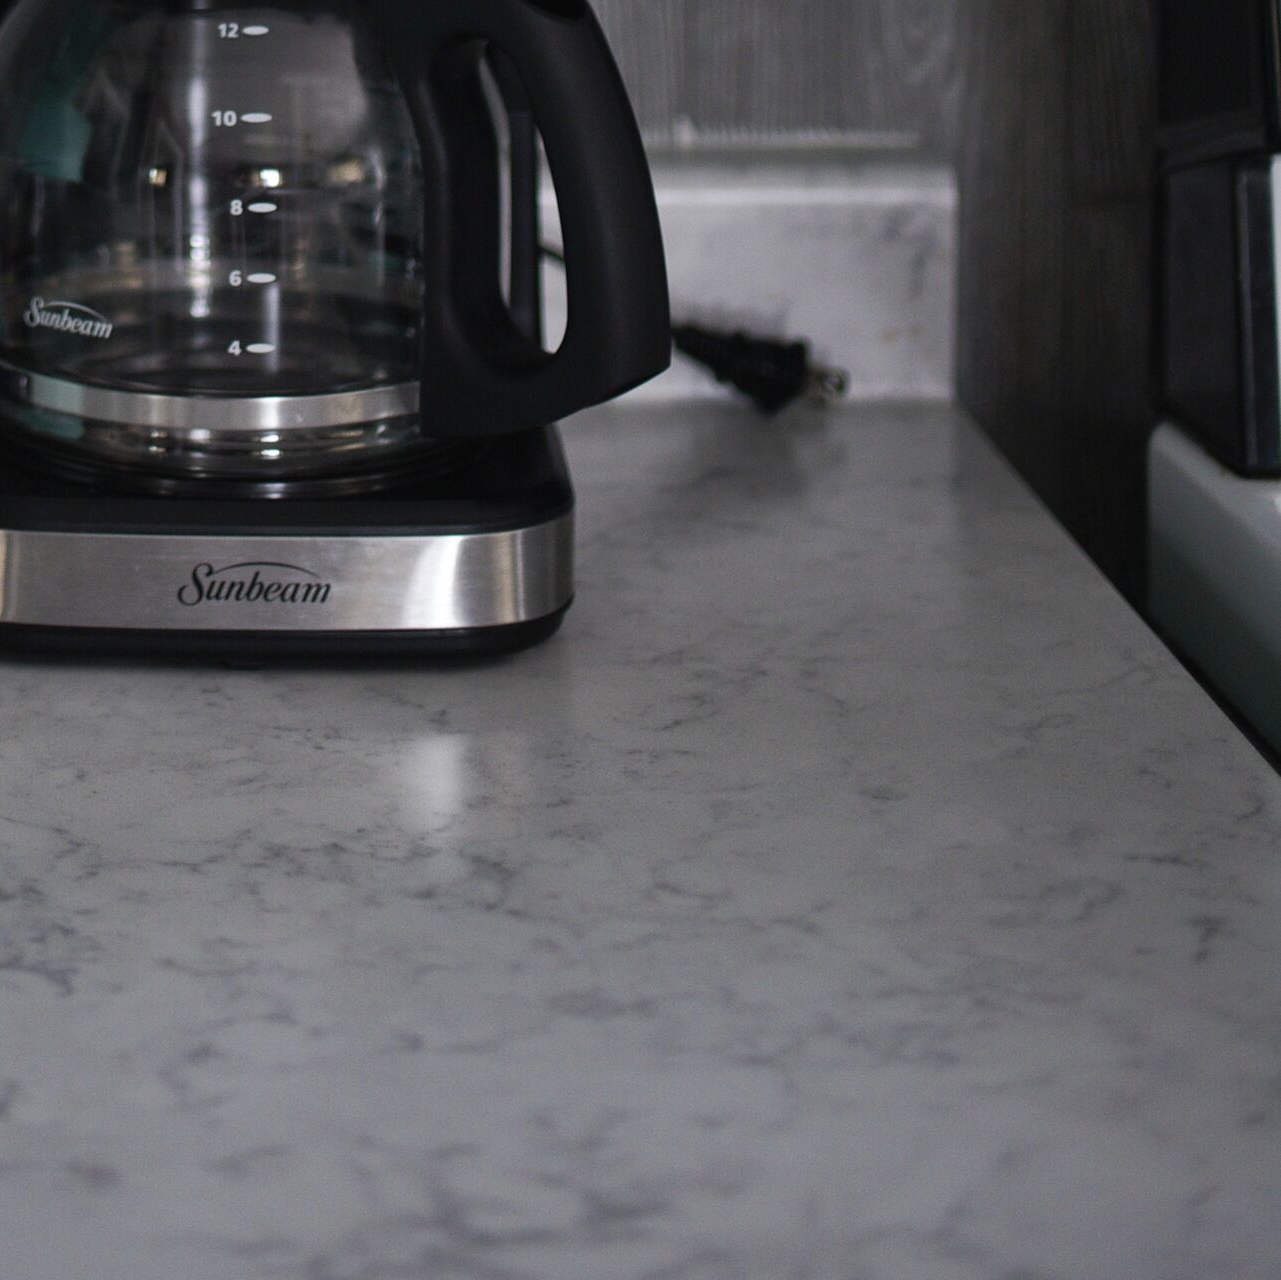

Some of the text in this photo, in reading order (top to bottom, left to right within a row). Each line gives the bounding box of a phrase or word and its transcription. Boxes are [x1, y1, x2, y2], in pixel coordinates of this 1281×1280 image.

[218, 22, 240, 39] 12
[211, 110, 237, 127] 10
[229, 199, 243, 216] 8
[228, 270, 242, 287] 6
[23, 296, 113, 339] Sunbeam
[227, 340, 242, 356] 4
[177, 562, 331, 606] Sunbeam
